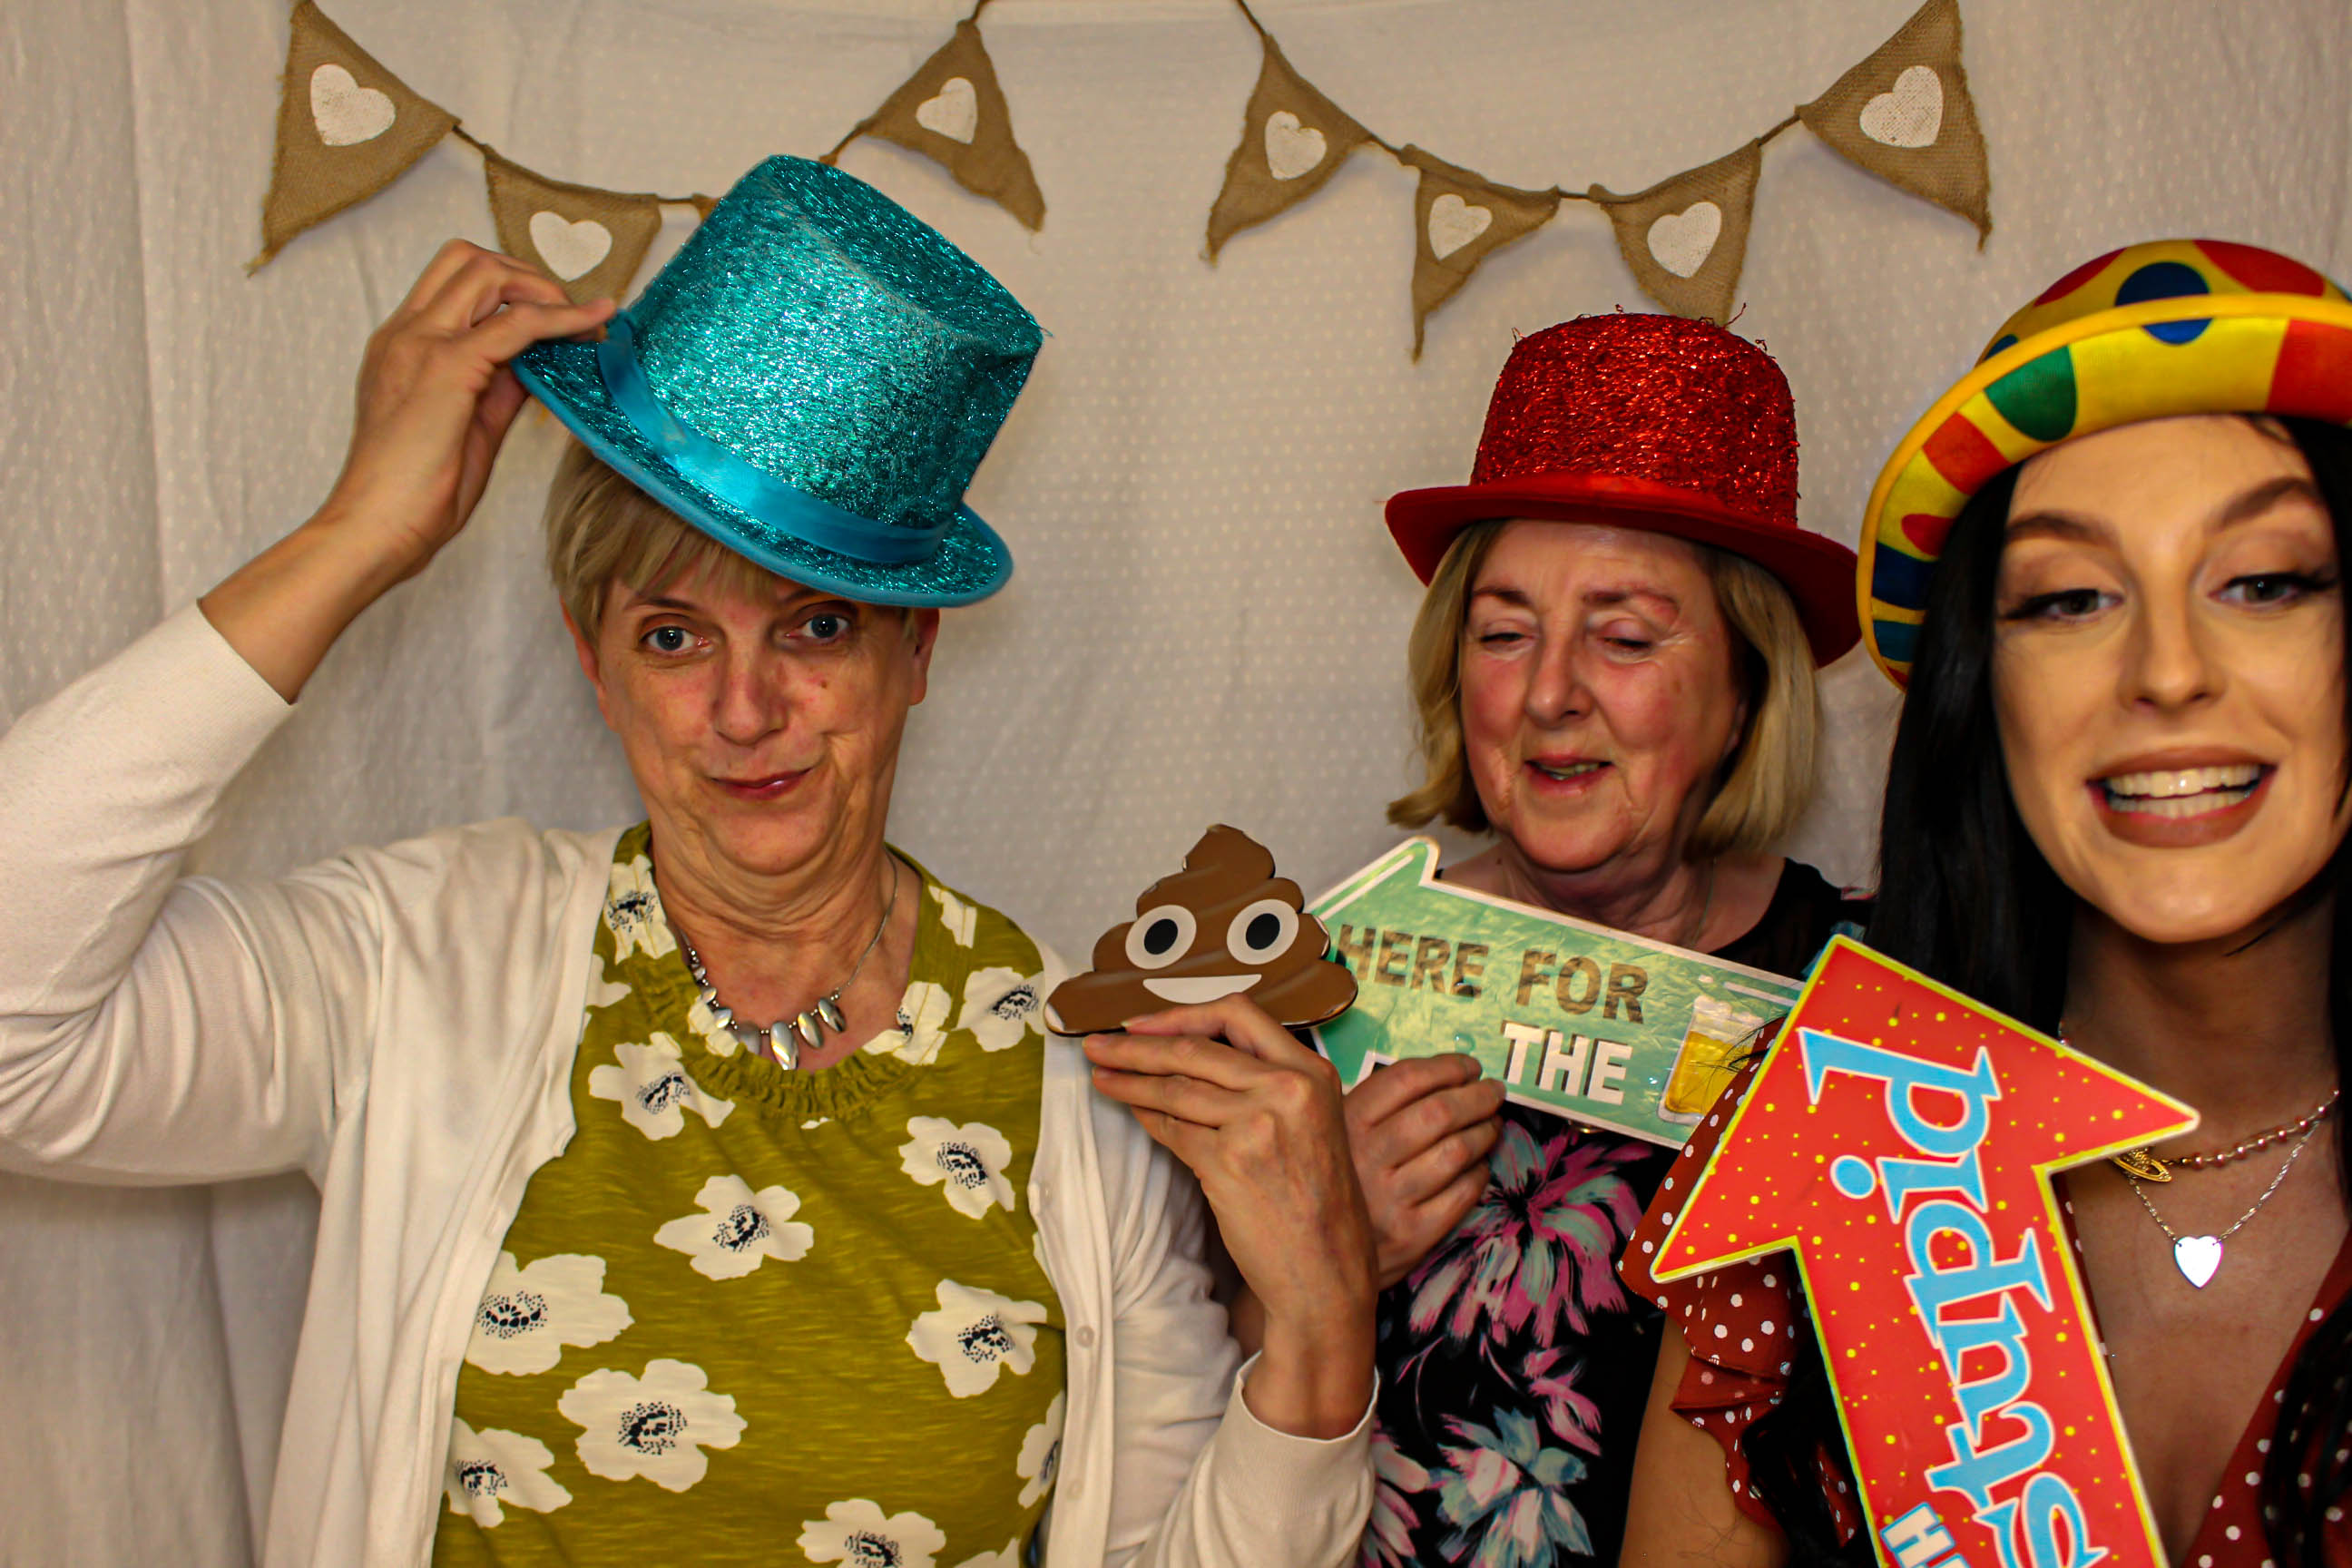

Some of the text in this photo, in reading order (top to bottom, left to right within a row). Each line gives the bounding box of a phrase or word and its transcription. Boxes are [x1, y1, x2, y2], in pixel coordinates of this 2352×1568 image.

[1336, 924, 1648, 1024] HERE FOR
[1502, 1021, 1632, 1105] THE
